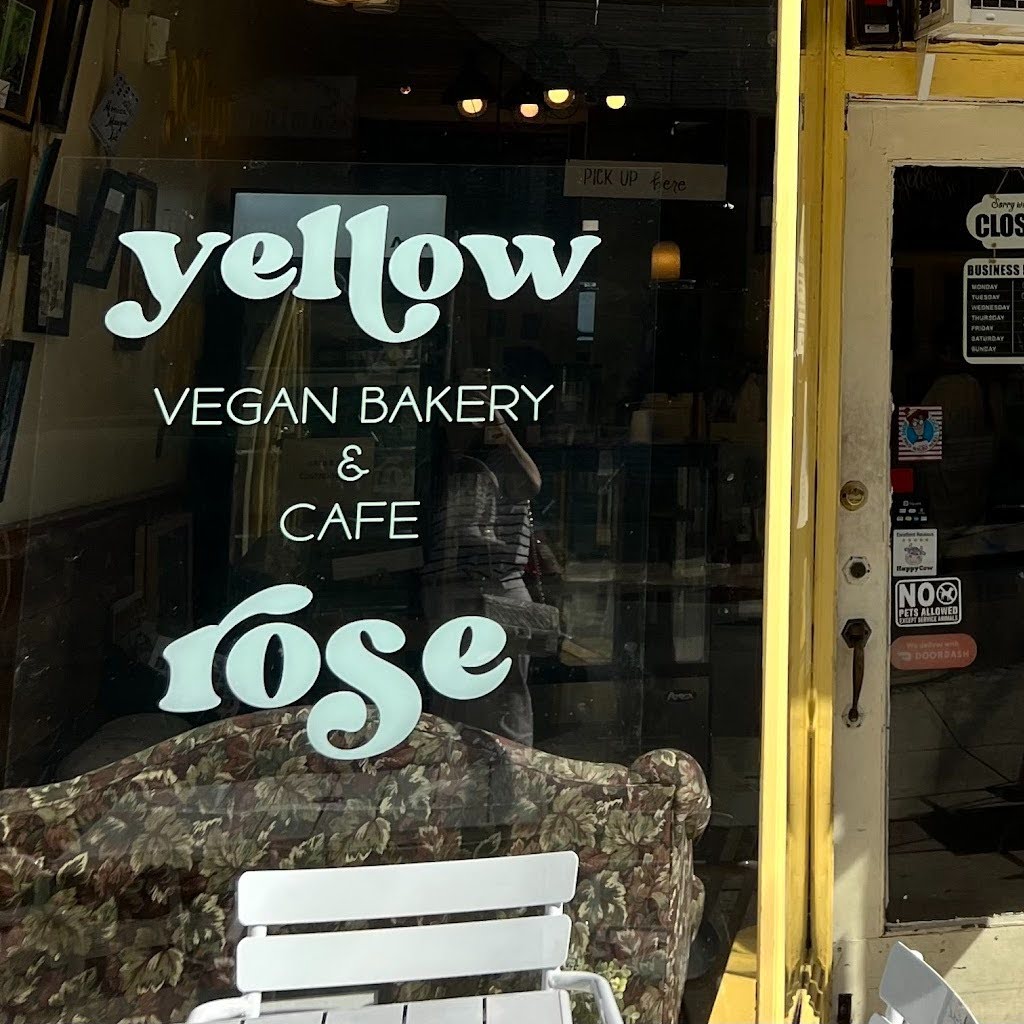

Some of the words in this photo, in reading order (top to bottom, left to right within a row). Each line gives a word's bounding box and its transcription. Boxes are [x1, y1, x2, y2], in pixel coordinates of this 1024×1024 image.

[583, 167, 613, 186] PICK
[619, 169, 639, 187] UP
[649, 171, 687, 194] here
[991, 197, 1015, 212] Sorry
[104, 204, 602, 343] yellow
[967, 264, 1020, 276] BUSINESS
[153, 385, 340, 426] VEGAN
[361, 383, 555, 424] BAKERY
[337, 444, 370, 481] &
[279, 500, 421, 543] CAFE
[899, 582, 935, 608] NO
[899, 608, 919, 617] PETS
[921, 606, 958, 616] ALLOWED
[906, 641, 916, 649] We
[915, 649, 970, 660] DOORDASH
[158, 583, 512, 761] rose
